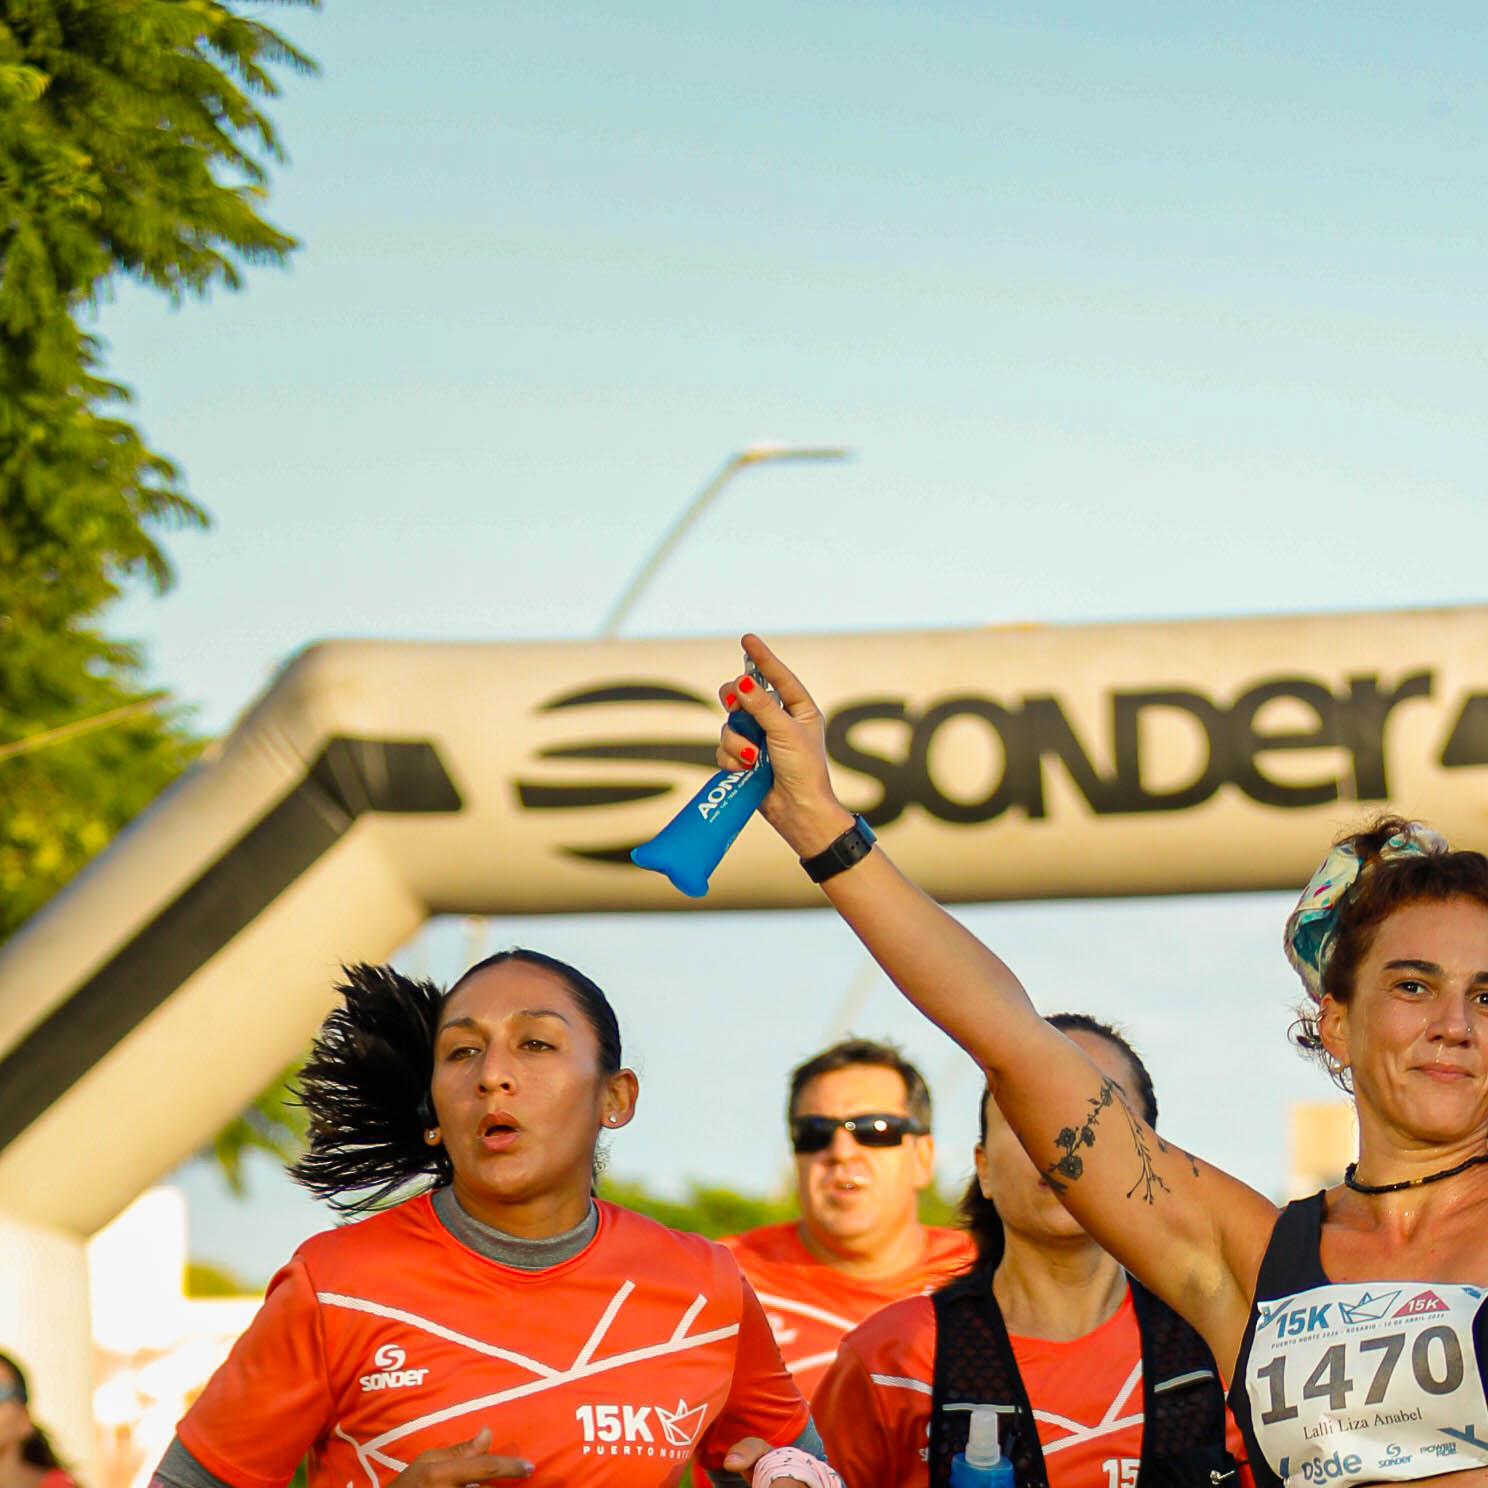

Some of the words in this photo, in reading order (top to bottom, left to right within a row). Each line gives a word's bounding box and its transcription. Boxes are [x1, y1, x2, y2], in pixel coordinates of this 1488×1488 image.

[1276, 1303, 1333, 1339] 15K
[1408, 1298, 1440, 1312] 15K
[1256, 1325, 1464, 1425] 1470
[576, 1404, 655, 1442] 15K
[1303, 1418, 1334, 1440] Lalli
[1338, 1416, 1369, 1433] Liza
[1373, 1407, 1423, 1427] Anabel
[583, 1446, 654, 1457] PUERTO
